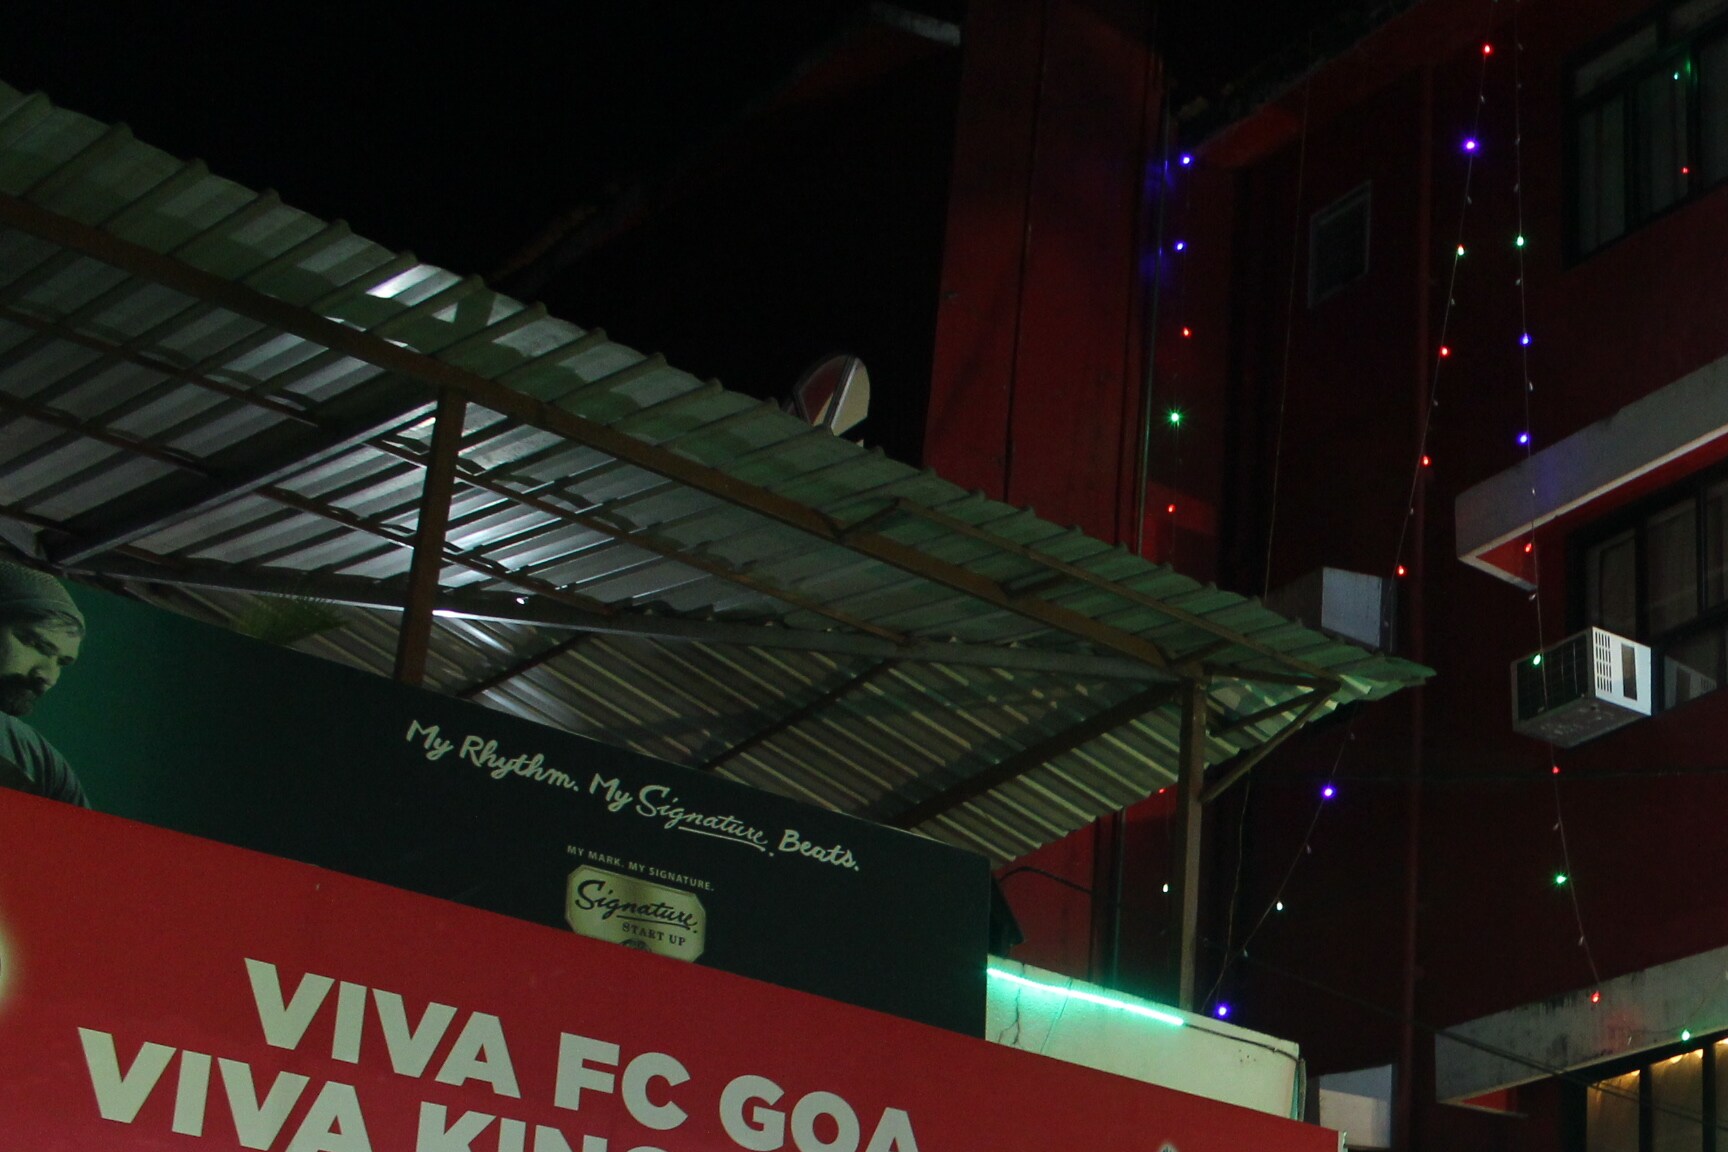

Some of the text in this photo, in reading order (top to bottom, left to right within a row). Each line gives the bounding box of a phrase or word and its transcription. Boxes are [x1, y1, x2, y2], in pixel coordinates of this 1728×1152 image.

[405, 719, 454, 761] My
[459, 735, 579, 792] Rhythm.
[589, 773, 633, 812] My
[778, 829, 860, 871] Beats.
[567, 845, 715, 891] MY MARK. MY SIGNATURE.
[622, 922, 686, 946] START UP
[244, 957, 522, 1099] VIVA
[553, 1032, 692, 1132] FC
